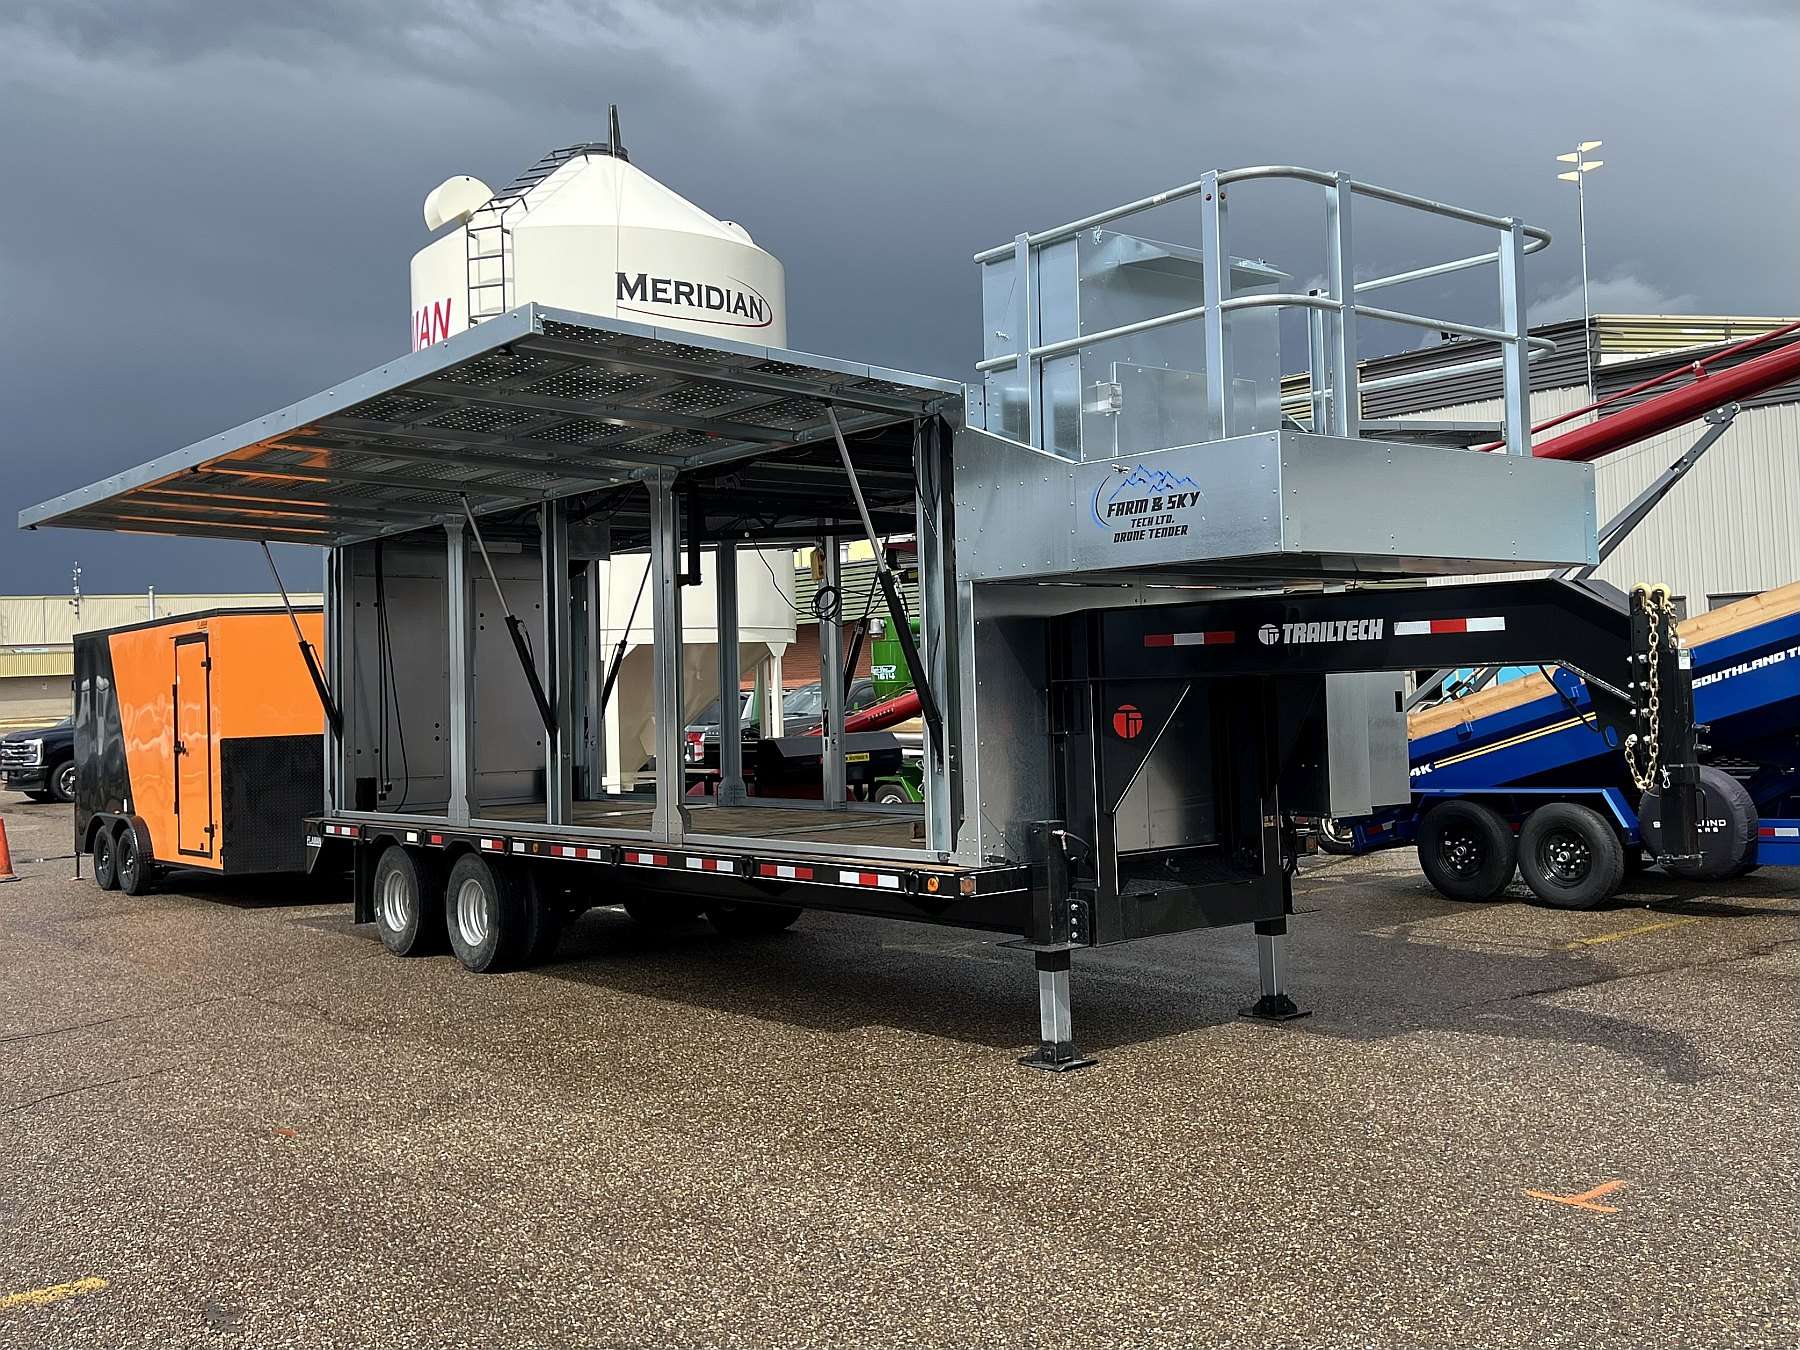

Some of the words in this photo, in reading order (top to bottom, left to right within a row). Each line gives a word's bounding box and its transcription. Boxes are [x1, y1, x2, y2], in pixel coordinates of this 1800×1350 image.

[615, 272, 763, 322] MERIDIAN
[1107, 498, 1148, 517] FARM
[1151, 496, 1163, 512] &
[1167, 491, 1200, 509] SKY
[1113, 530, 1145, 543] DRONE
[1148, 525, 1188, 539] TENDER
[1131, 517, 1155, 528] TECH
[1156, 515, 1174, 525] LTD.
[1282, 618, 1384, 644] TRAILTECH
[1691, 650, 1785, 690] SOUTHLAND
